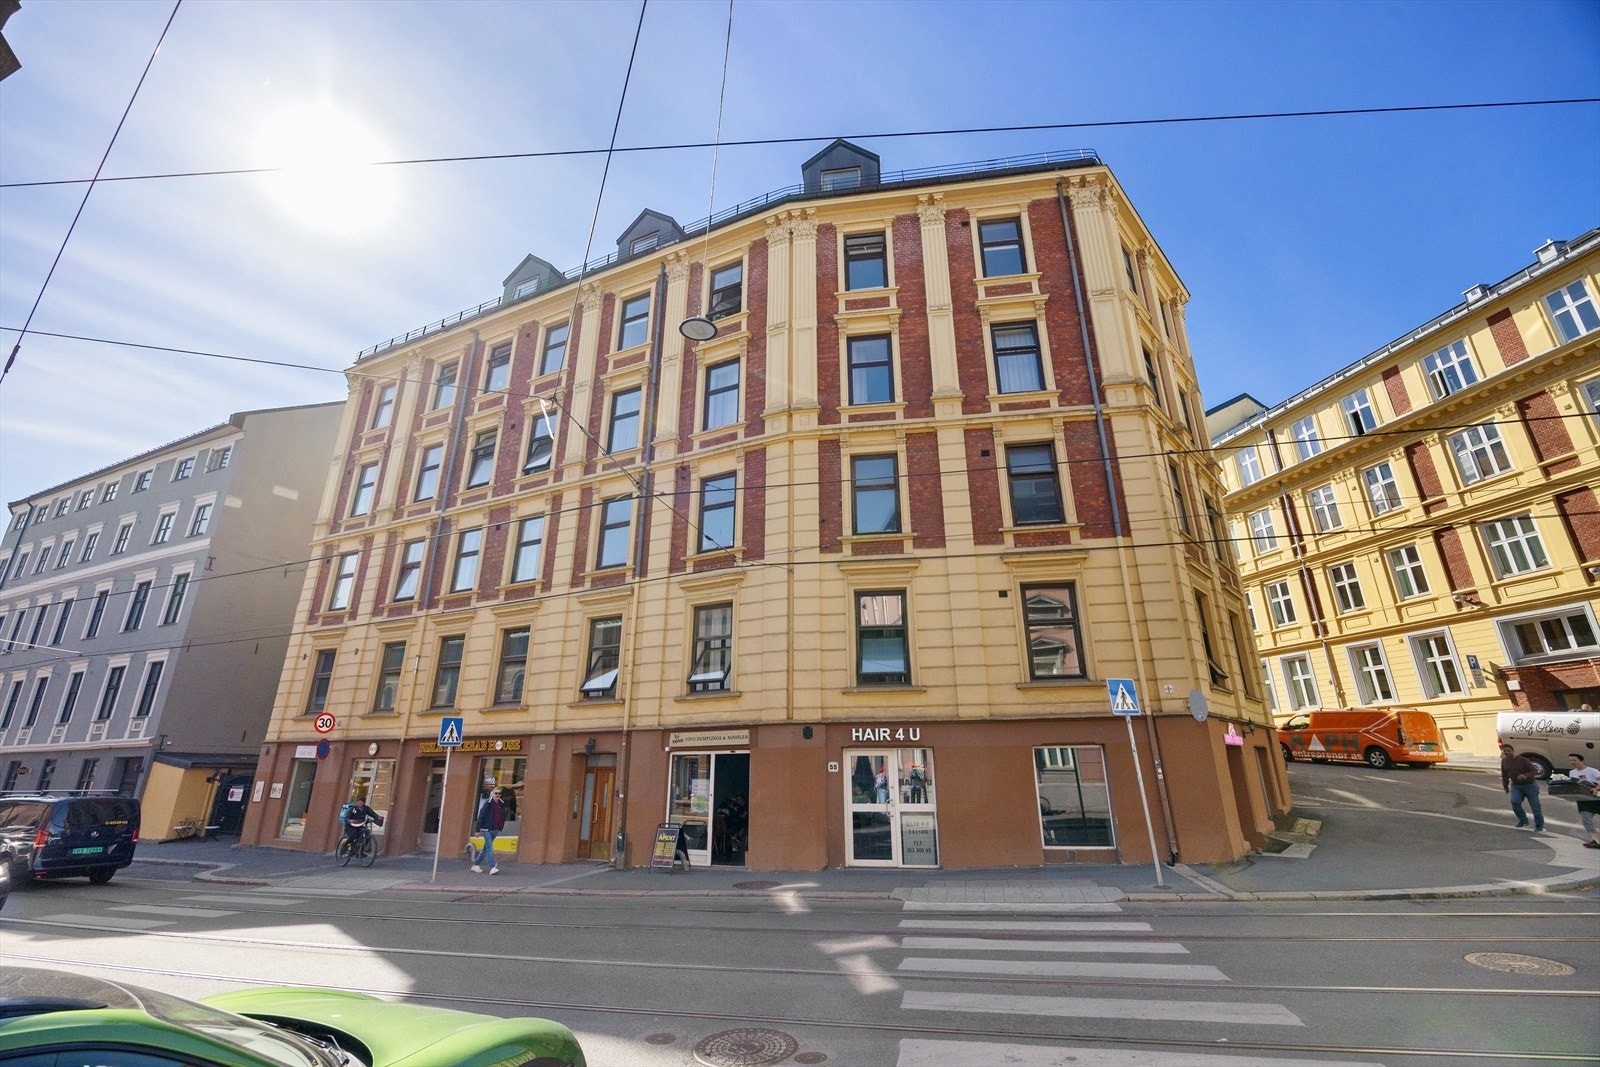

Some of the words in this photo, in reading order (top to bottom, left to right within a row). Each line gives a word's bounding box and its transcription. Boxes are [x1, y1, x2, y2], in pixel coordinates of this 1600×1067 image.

[318, 718, 332, 728] 30
[1511, 718, 1535, 736] Rolf
[1536, 719, 1565, 735] Olsen
[852, 728, 890, 740] HAIR
[896, 728, 904, 740] 4
[910, 728, 920, 740] U
